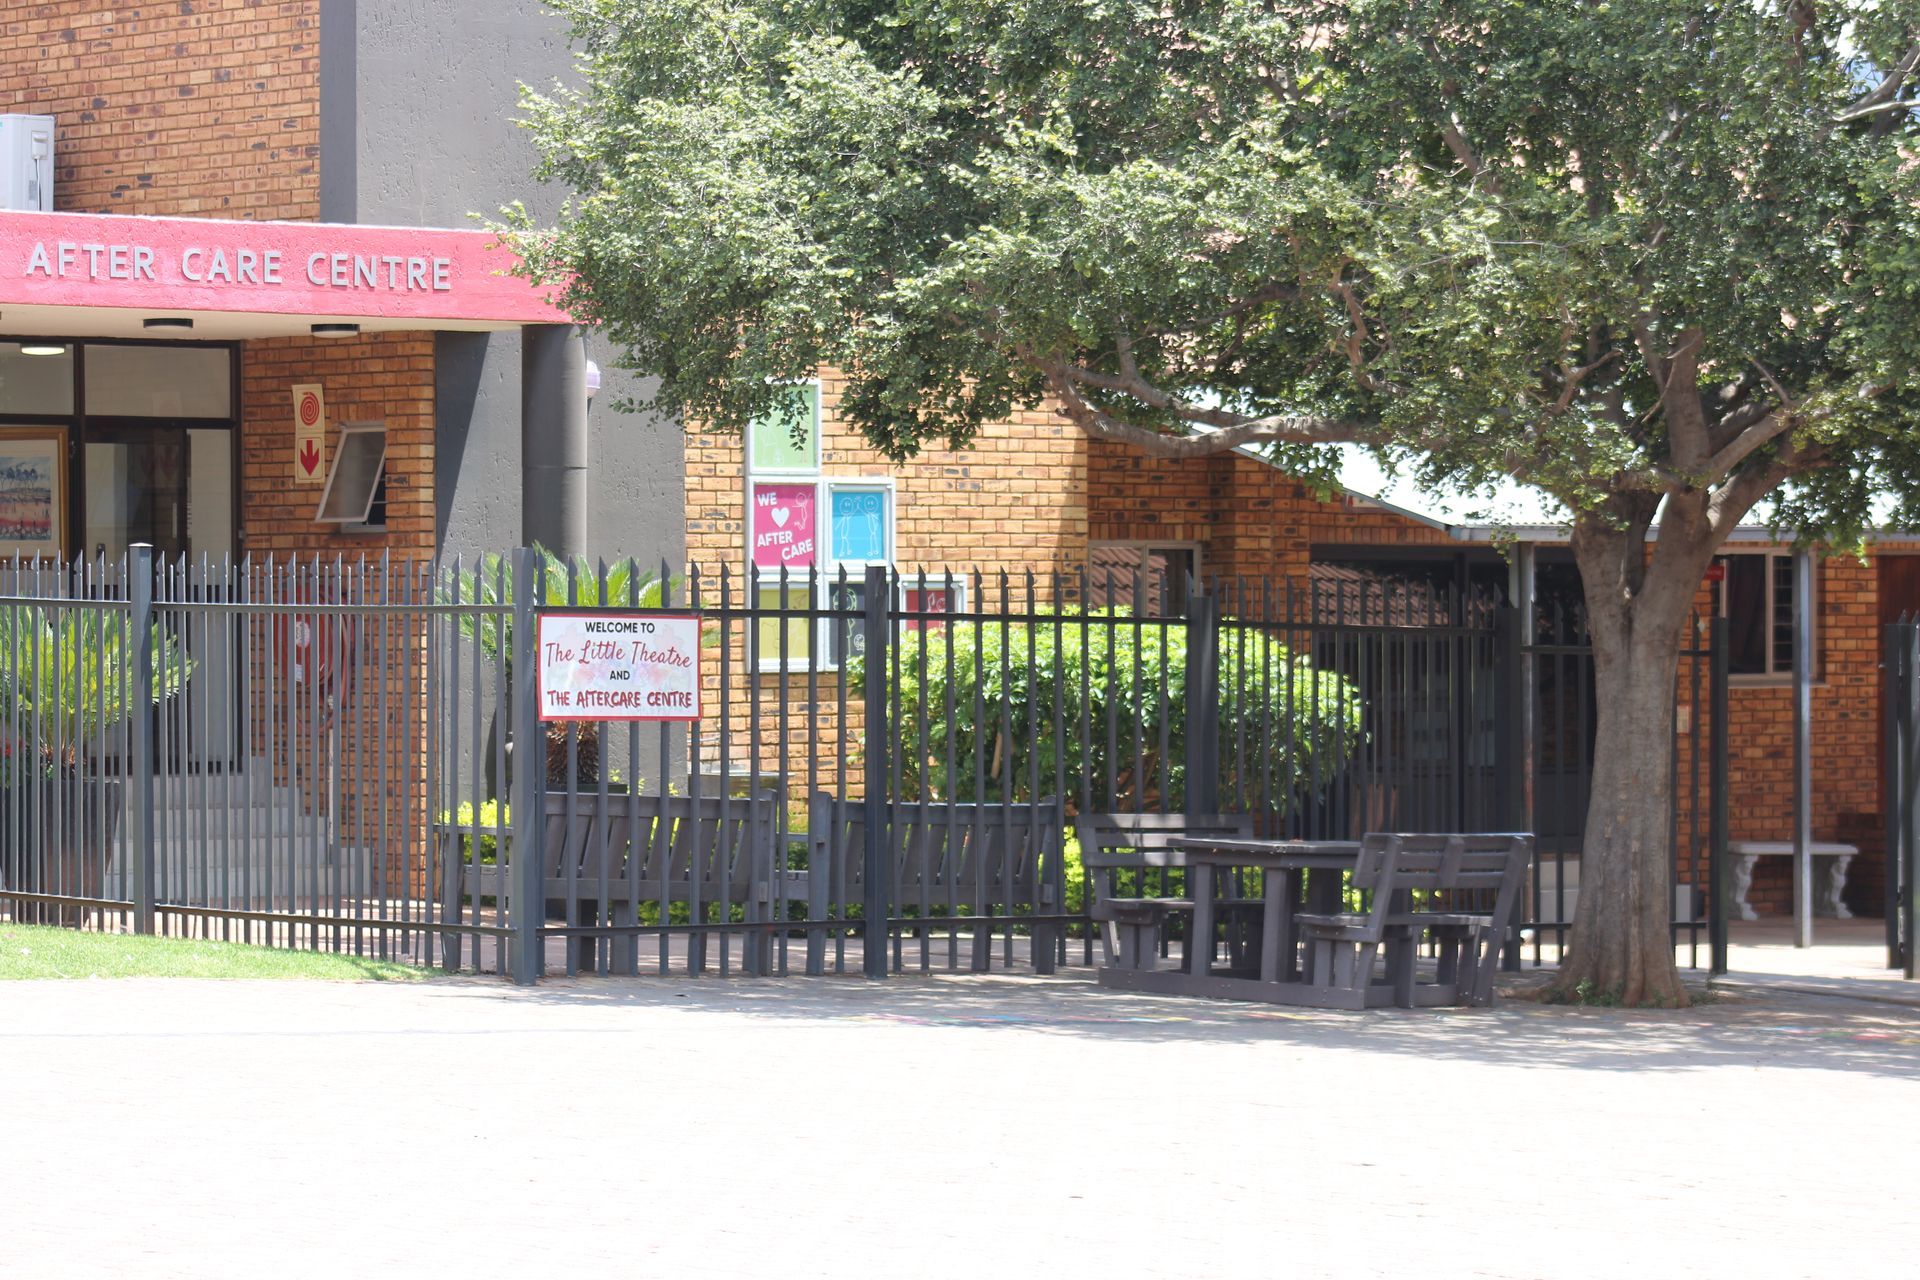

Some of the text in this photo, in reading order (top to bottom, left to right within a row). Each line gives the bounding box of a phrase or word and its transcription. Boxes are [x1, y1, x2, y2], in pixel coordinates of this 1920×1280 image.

[26, 241, 451, 291] AFTER CARE CENTRE
[757, 492, 778, 507] WE
[757, 530, 793, 547] AFTER
[781, 538, 814, 560] CARE
[585, 621, 655, 633] WELCOME TO
[545, 639, 692, 669] The Little Theatre
[609, 670, 631, 681] AND
[547, 689, 693, 709] THE AFTERCARE CENTRE
